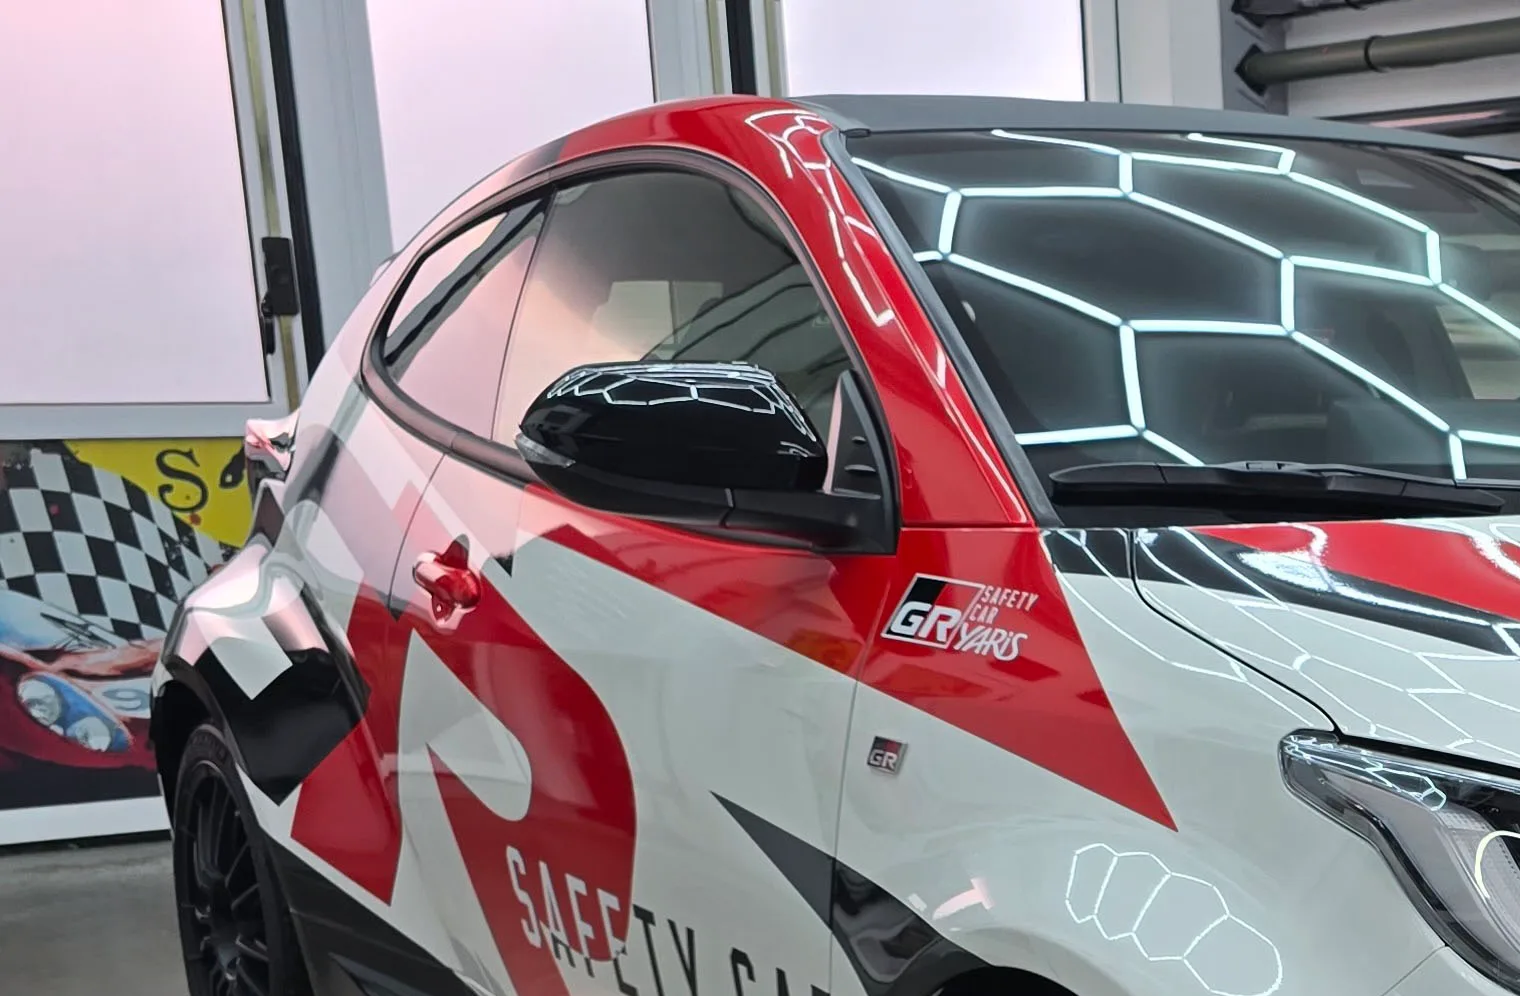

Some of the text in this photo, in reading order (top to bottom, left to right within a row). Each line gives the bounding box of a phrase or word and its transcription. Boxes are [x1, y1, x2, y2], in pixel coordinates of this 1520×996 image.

[156, 448, 208, 512] S
[981, 585, 1039, 611] SAFETY
[890, 601, 962, 642] GR
[969, 603, 999, 624] CAR
[870, 749, 898, 769] GR
